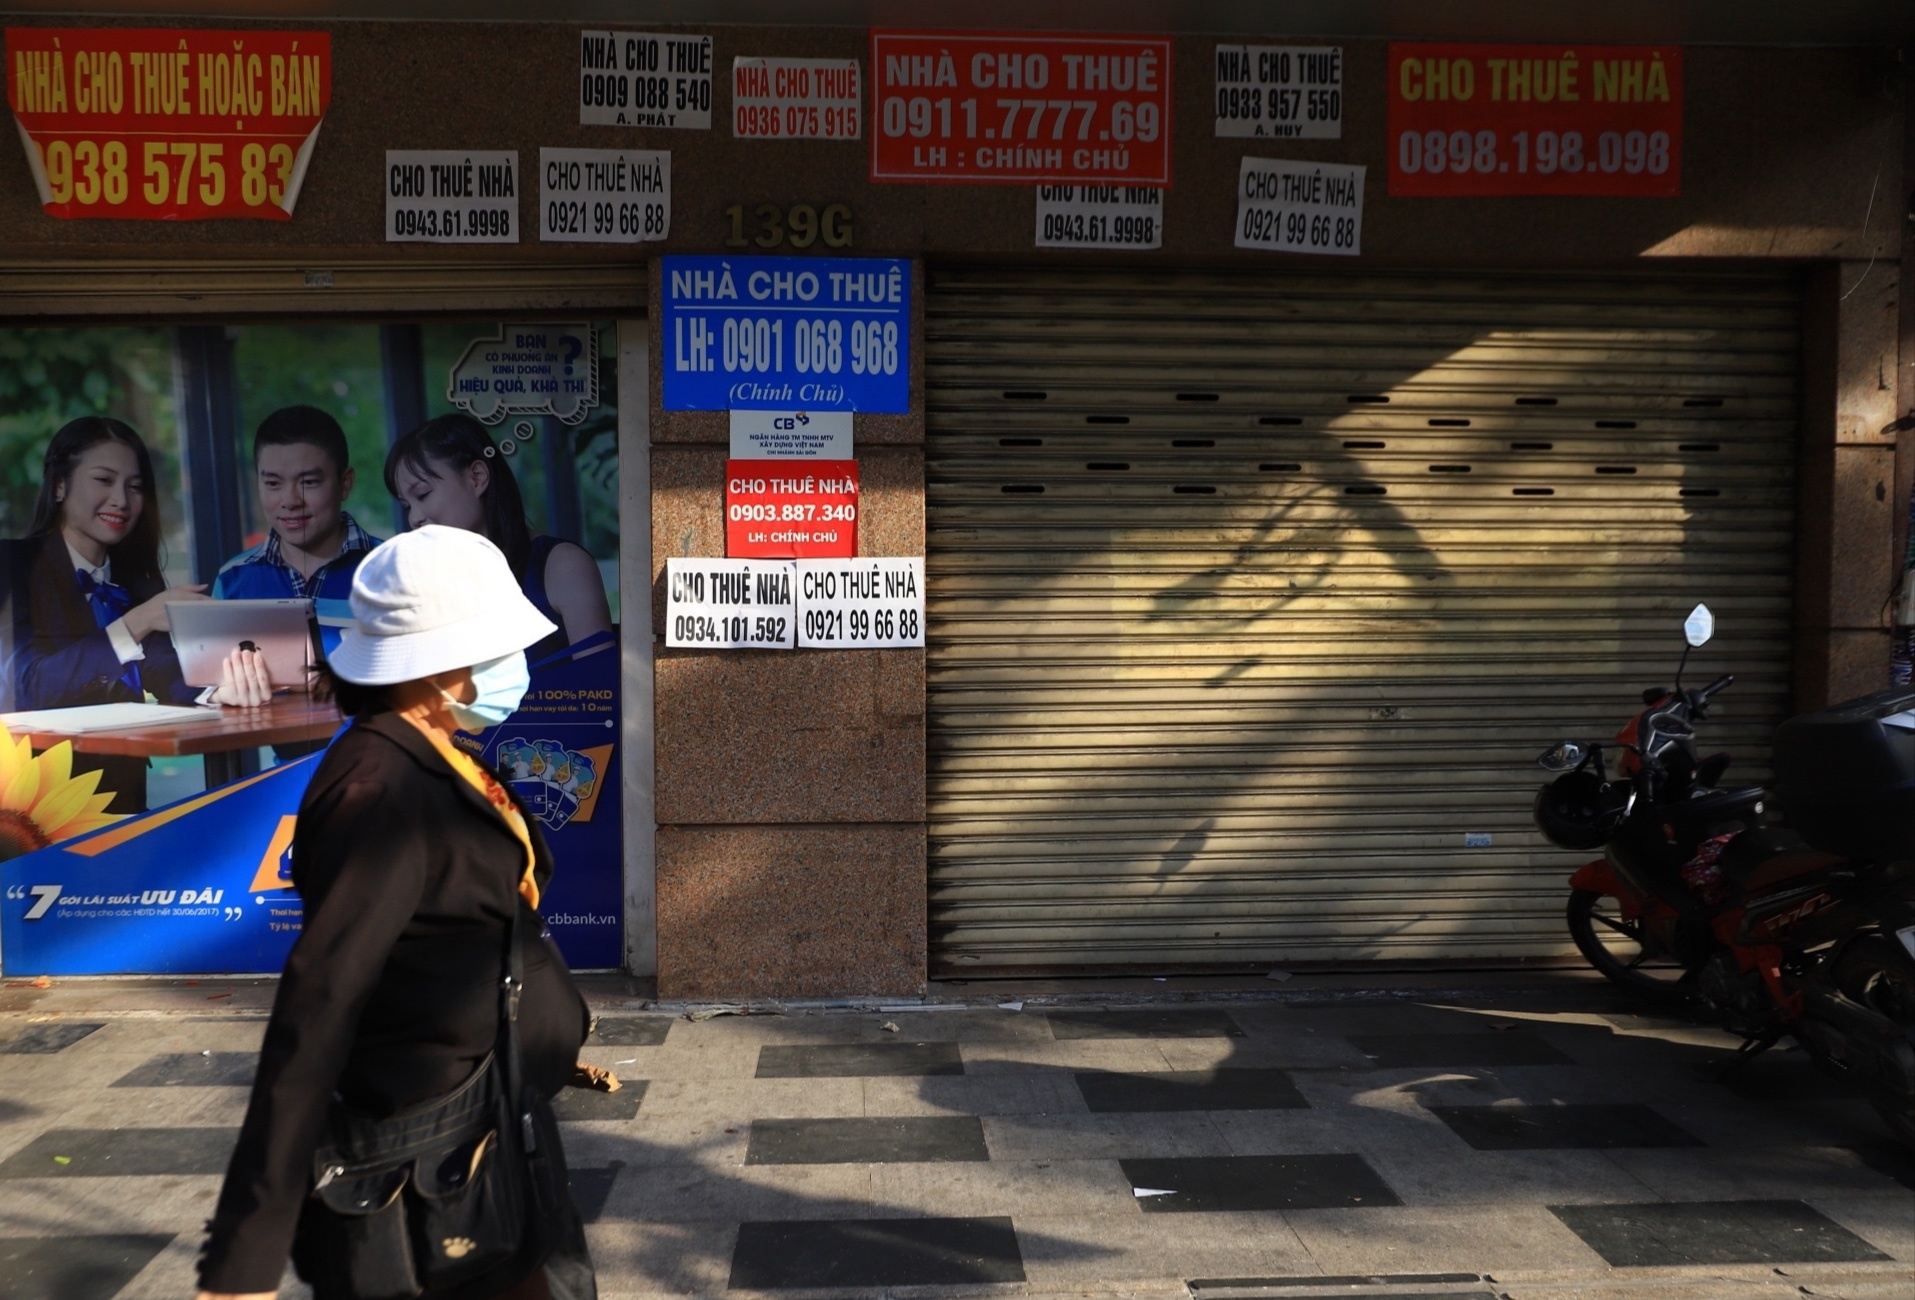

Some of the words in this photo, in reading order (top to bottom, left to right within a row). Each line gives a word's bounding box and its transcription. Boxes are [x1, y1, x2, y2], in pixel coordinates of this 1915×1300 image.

[582, 32, 617, 70] NHÀ
[626, 38, 659, 72] CHO
[667, 36, 711, 74] THUÊ
[1218, 46, 1251, 82] NHÀ
[1259, 52, 1290, 83] CHO
[1298, 47, 1340, 84] THUÊ
[16, 37, 68, 113] NHÀ
[74, 50, 124, 115] CHO
[130, 39, 191, 115] THUÊ
[199, 40, 263, 131] HOẶC
[270, 41, 320, 117] BÁN
[736, 60, 770, 98] NHÀ
[776, 68, 810, 99] CHO
[815, 62, 857, 100] THUÊ
[886, 49, 958, 87] NHÀ
[971, 53, 1049, 90] CHO
[1062, 49, 1159, 93] THUÊ
[1400, 56, 1475, 102] CHO
[1487, 50, 1580, 102] THUÊ
[1593, 51, 1670, 103] NHÀ
[582, 74, 628, 108] 0909
[635, 76, 669, 110] 088
[676, 79, 710, 112] 540
[1220, 88, 1261, 119] 0933
[1269, 89, 1302, 120] 957
[1308, 90, 1340, 120] 550
[617, 113, 631, 125] A.
[637, 111, 676, 127] PHÁT
[737, 106, 780, 135] 0936
[786, 106, 818, 136] 075
[825, 107, 857, 137] 915
[883, 96, 1159, 143] 0911.7777.69
[1255, 125, 1269, 136] A.
[1275, 125, 1303, 136] HUY
[914, 146, 947, 167] LH
[976, 144, 1062, 169] CHÍNH
[1073, 143, 1129, 170] CHỦ
[1400, 130, 1670, 175] 0898.198.098
[33, 139, 128, 206] 938
[143, 142, 226, 207] 575
[390, 165, 424, 198] CHO
[430, 158, 473, 197] THUÊ
[479, 158, 514, 197] NHÀ
[548, 162, 581, 191] CHO
[586, 155, 626, 191] THUÊ
[631, 157, 663, 193] NHÀ
[1246, 171, 1278, 199] CHO
[1283, 169, 1321, 203] THUÊ
[395, 210, 510, 237] 0943.61.9998
[549, 201, 587, 233] 0921
[594, 202, 614, 234] 99
[620, 203, 639, 234] 66
[645, 203, 664, 235] 88
[726, 203, 853, 248] 139G
[1044, 214, 1153, 243] 0943.61.9998
[1244, 208, 1282, 241] 0921
[1288, 213, 1306, 244] 99
[1312, 215, 1330, 246] 66
[1335, 217, 1355, 248] 88
[672, 261, 738, 300] NHÀ
[748, 271, 820, 301] CHO
[829, 265, 902, 303] THUÊ
[516, 334, 547, 352] BẠN
[559, 336, 582, 375] ?
[675, 317, 714, 372] LH:
[723, 317, 783, 372] 0901
[796, 319, 842, 374] 068
[851, 320, 898, 376] 968
[460, 377, 489, 395] HIỆU
[531, 376, 558, 392] KHẢ
[563, 380, 584, 392] THI
[492, 365, 514, 374] KINH
[518, 365, 551, 374] DOANH
[730, 382, 793, 403] (Chính
[800, 383, 844, 404] Chủ)
[774, 418, 794, 430] CB
[730, 479, 766, 494] CHO
[770, 475, 815, 494] THUÊ
[818, 475, 855, 494] NHÀ
[730, 504, 855, 521] 0903.887.340
[748, 532, 768, 542] LH:
[771, 529, 809, 542] CHÍNH
[813, 529, 838, 542] CHỦ
[672, 572, 705, 603] CHO
[710, 566, 751, 604] THUÊ
[757, 567, 791, 605] NHÀ
[804, 571, 836, 599] CHO
[841, 564, 880, 599] THUÊ
[886, 564, 917, 598] NHÀ
[676, 616, 786, 642] 0934.101.592
[806, 609, 843, 640] 0921
[850, 609, 869, 640] 99
[875, 609, 894, 640] 66
[899, 609, 918, 640] 88
[538, 690, 577, 700] 100%
[579, 690, 613, 700] PAKD
[582, 703, 596, 712] 10
[97, 909, 114, 917] cho
[173, 908, 219, 917] 30/06/2017)
[140, 890, 177, 905] ƯU
[179, 887, 224, 905] ĐÃI
